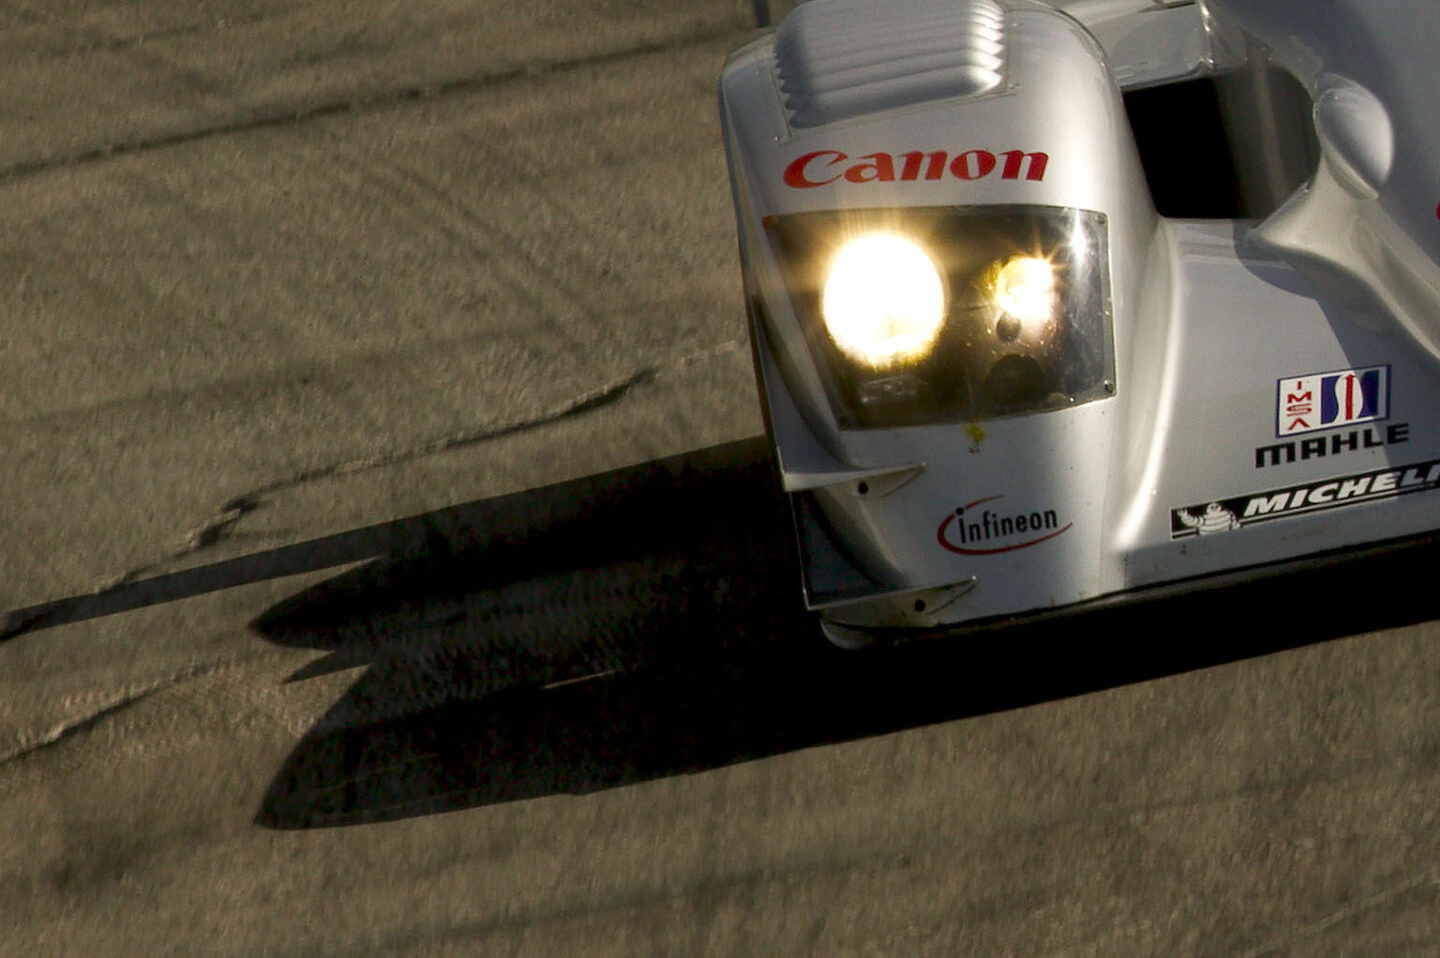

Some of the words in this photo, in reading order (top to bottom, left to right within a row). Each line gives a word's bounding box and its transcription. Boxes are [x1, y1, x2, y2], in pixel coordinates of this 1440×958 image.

[783, 149, 1049, 189] Canon
[1255, 422, 1409, 469] MAHLE
[954, 506, 1058, 544] infineon
